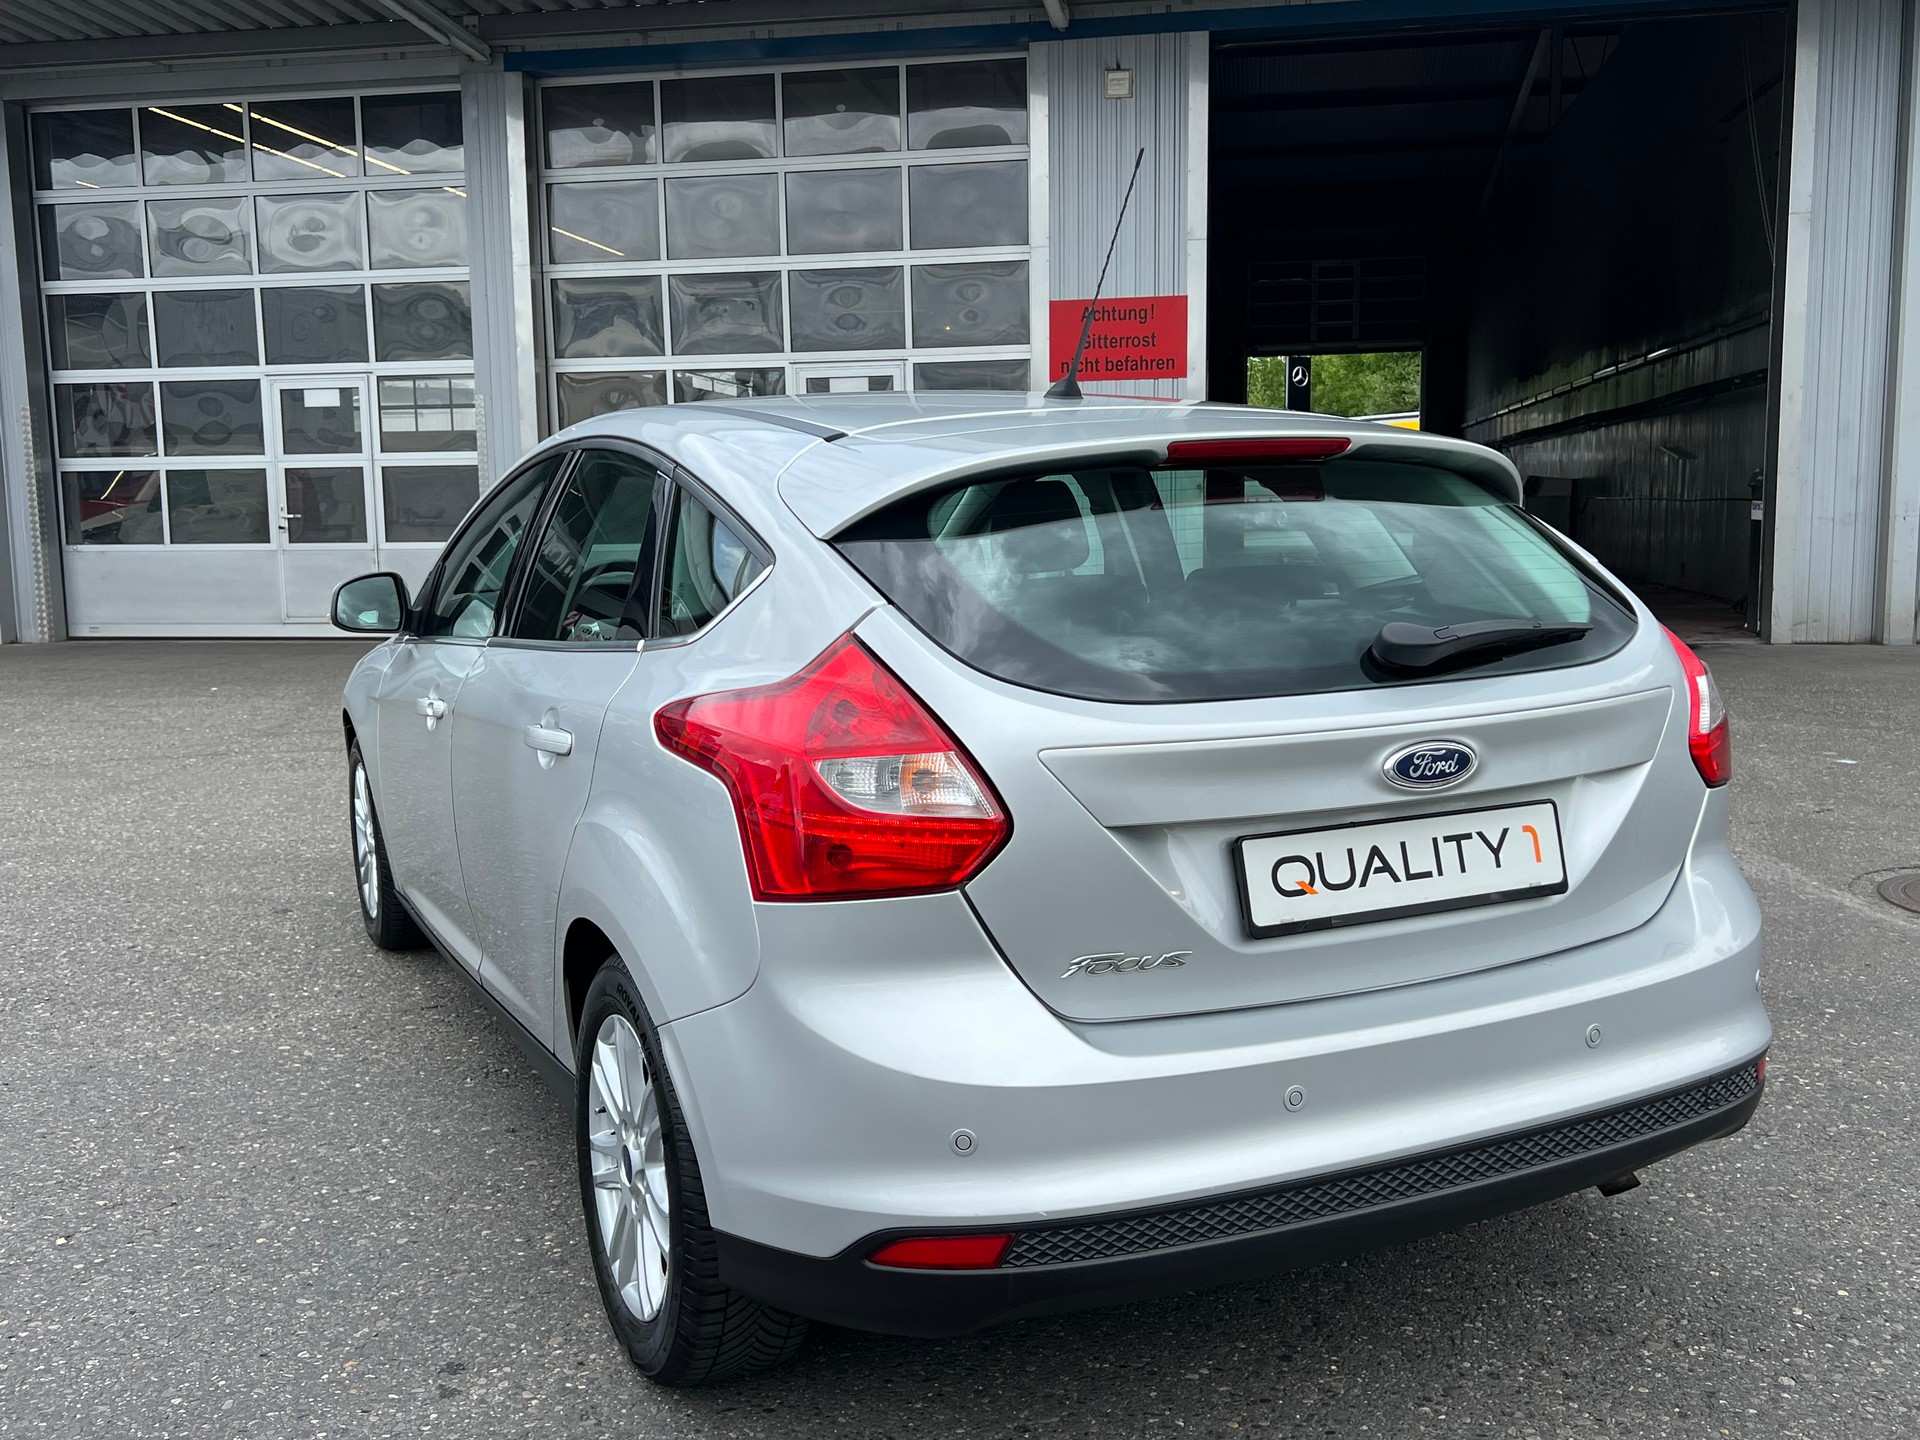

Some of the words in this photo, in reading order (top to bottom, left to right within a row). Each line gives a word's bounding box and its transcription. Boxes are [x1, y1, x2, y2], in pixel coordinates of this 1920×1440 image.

[1081, 304, 1155, 325] Achtung!
[1105, 355, 1175, 372] befahren
[1409, 749, 1459, 777] Ford
[1271, 827, 1510, 898] QUALITY
[616, 983, 640, 1029] ROYAL
